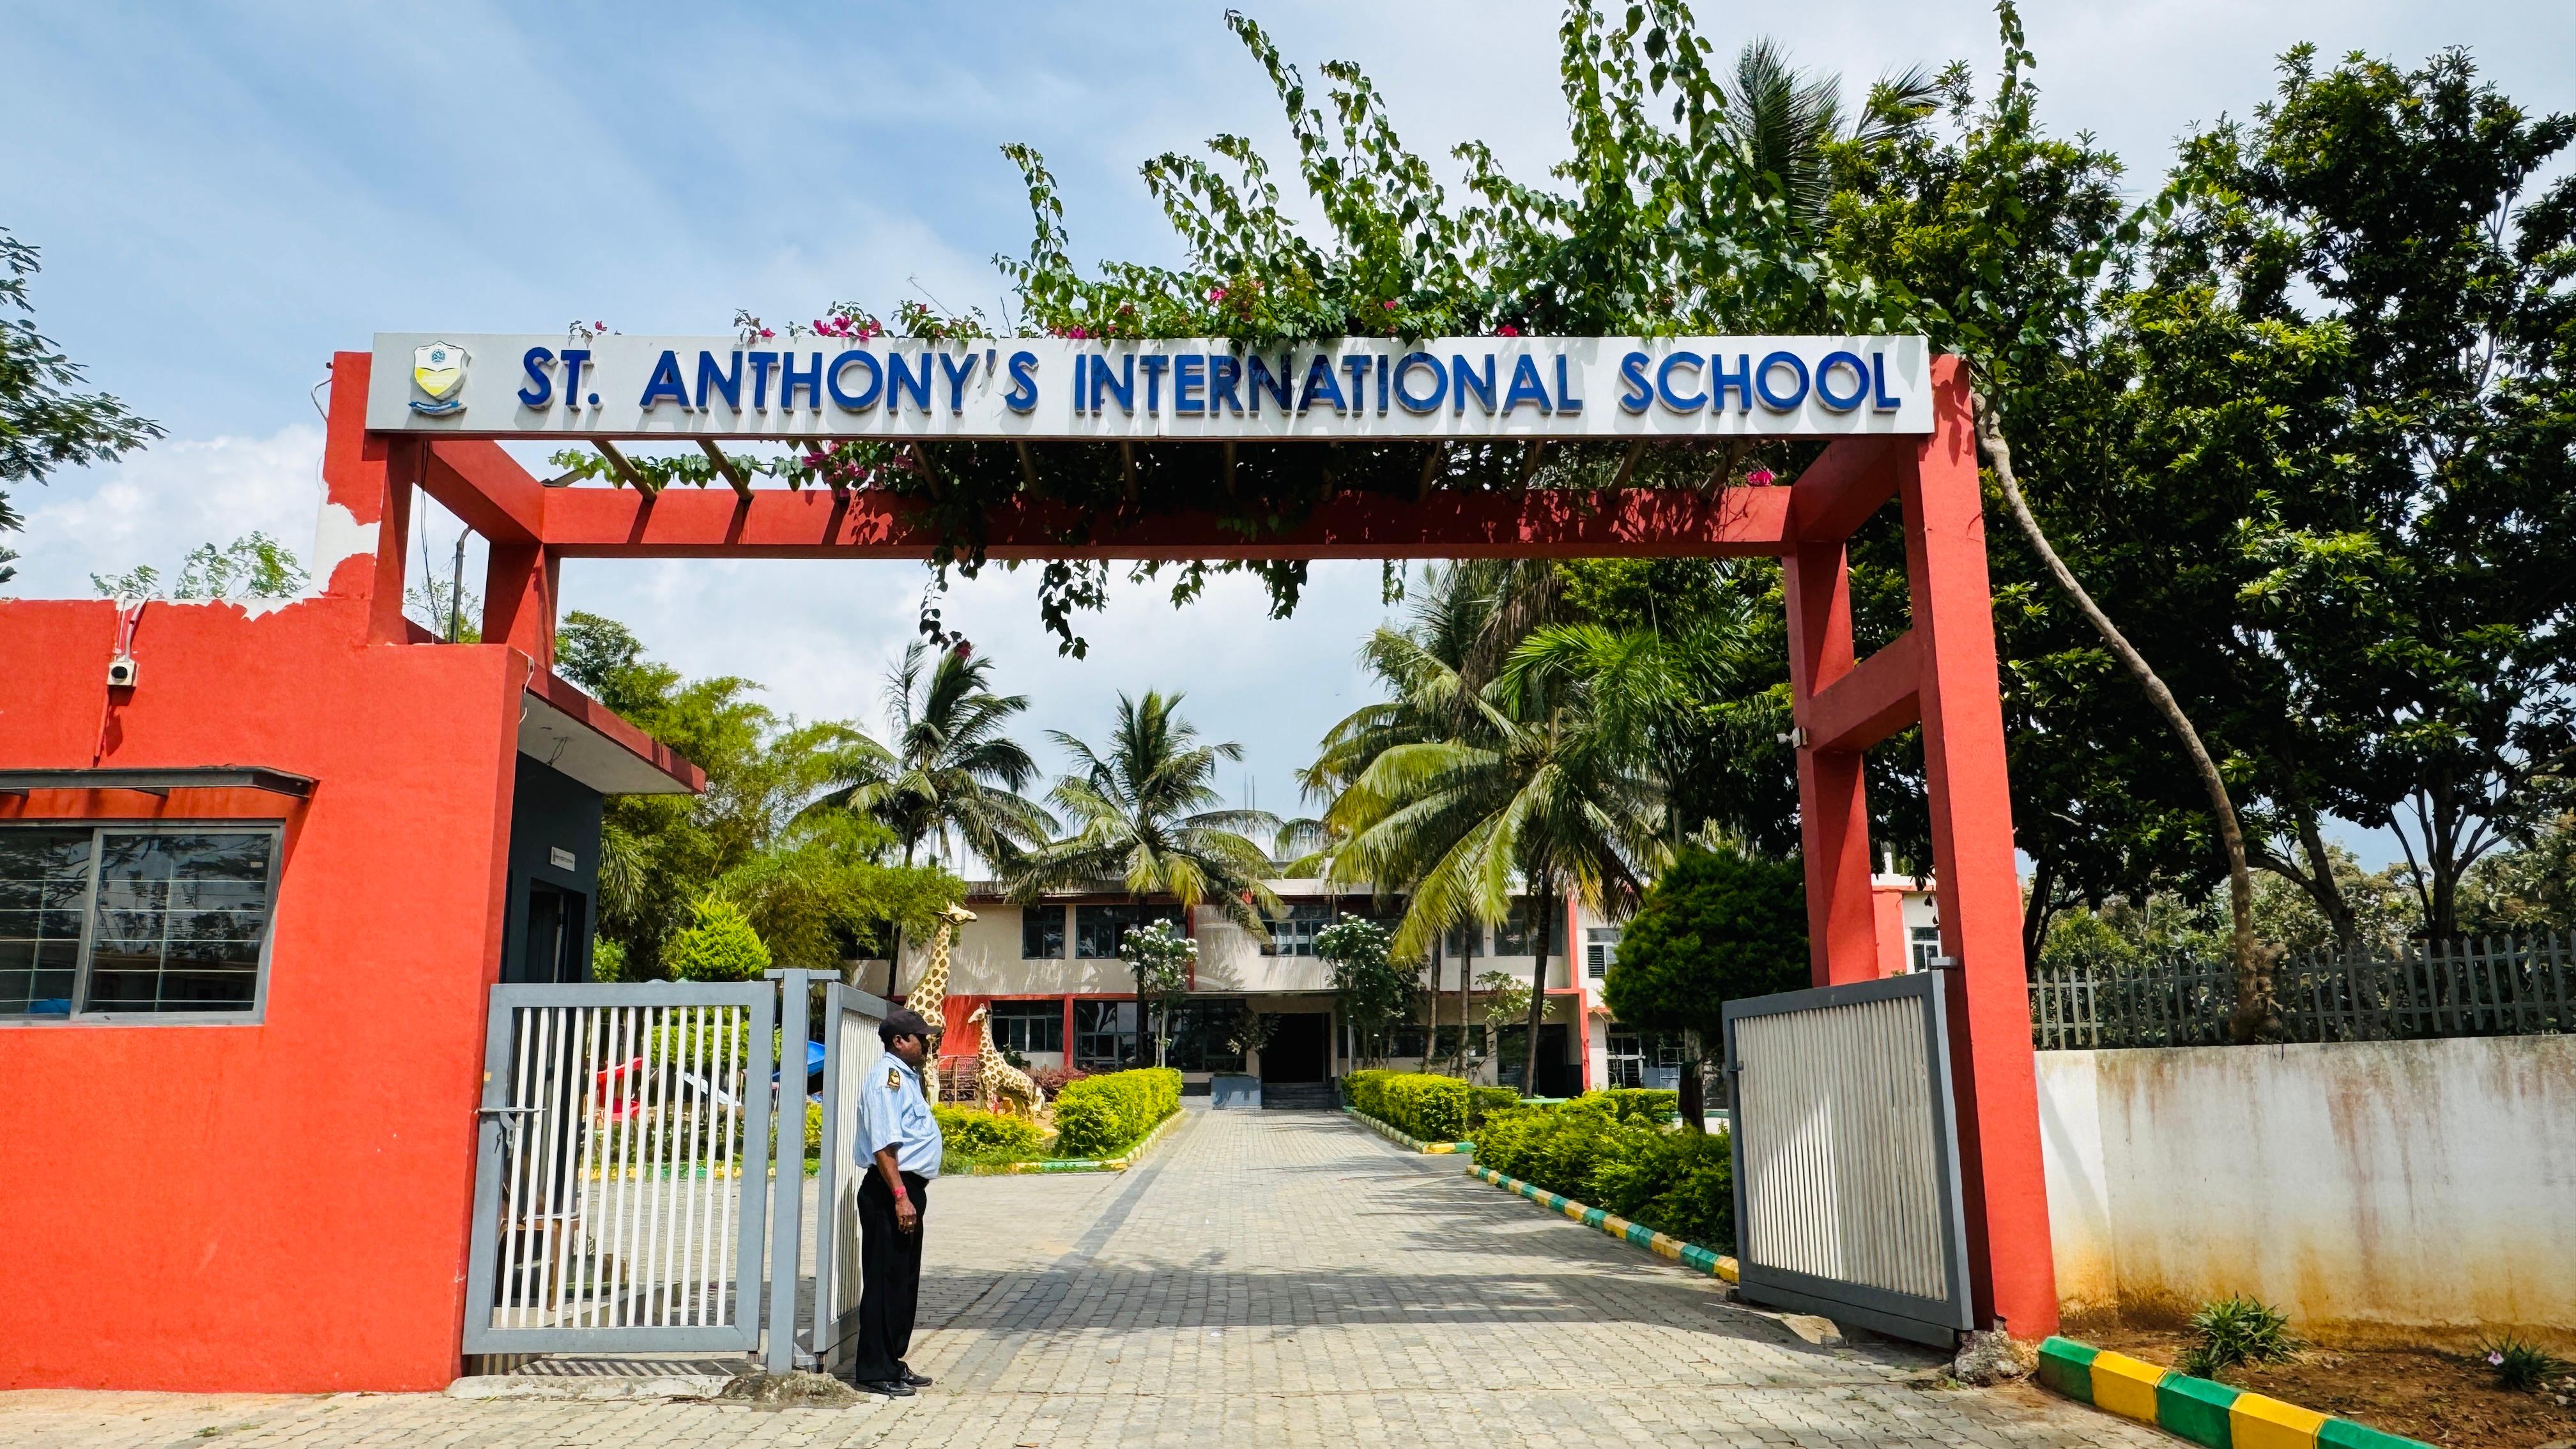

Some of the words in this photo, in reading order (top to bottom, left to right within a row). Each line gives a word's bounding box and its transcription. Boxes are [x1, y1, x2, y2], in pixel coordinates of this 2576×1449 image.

[518, 347, 602, 412] ST.
[640, 349, 1039, 414] ANTHONY'S
[1075, 351, 1583, 416] INTERNATIONAL
[1620, 351, 1901, 414] SCHOOL
